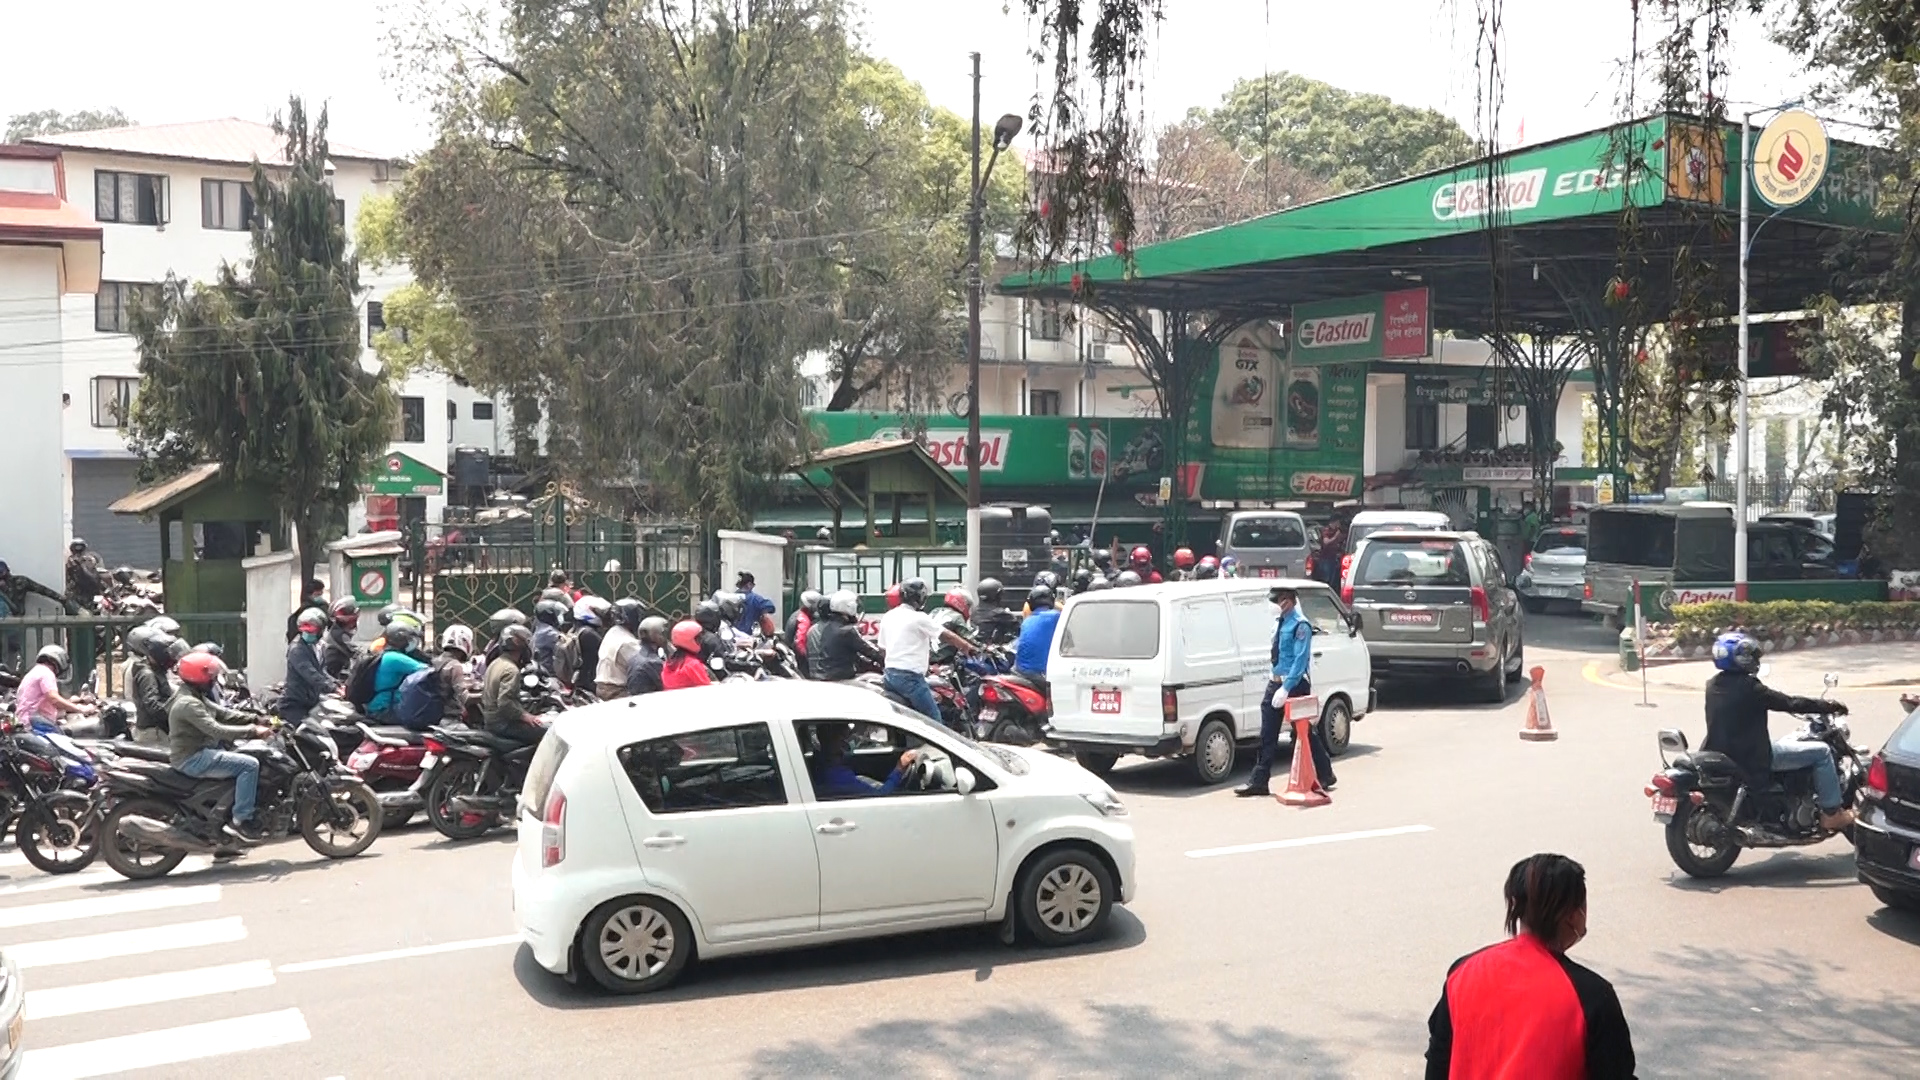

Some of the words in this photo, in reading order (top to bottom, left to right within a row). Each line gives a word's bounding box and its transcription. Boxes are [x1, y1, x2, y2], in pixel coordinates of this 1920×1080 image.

[1315, 317, 1369, 344] Castrol
[1235, 359, 1259, 372] GTX
[927, 436, 1001, 466] astol
[1306, 475, 1351, 492] Castrol
